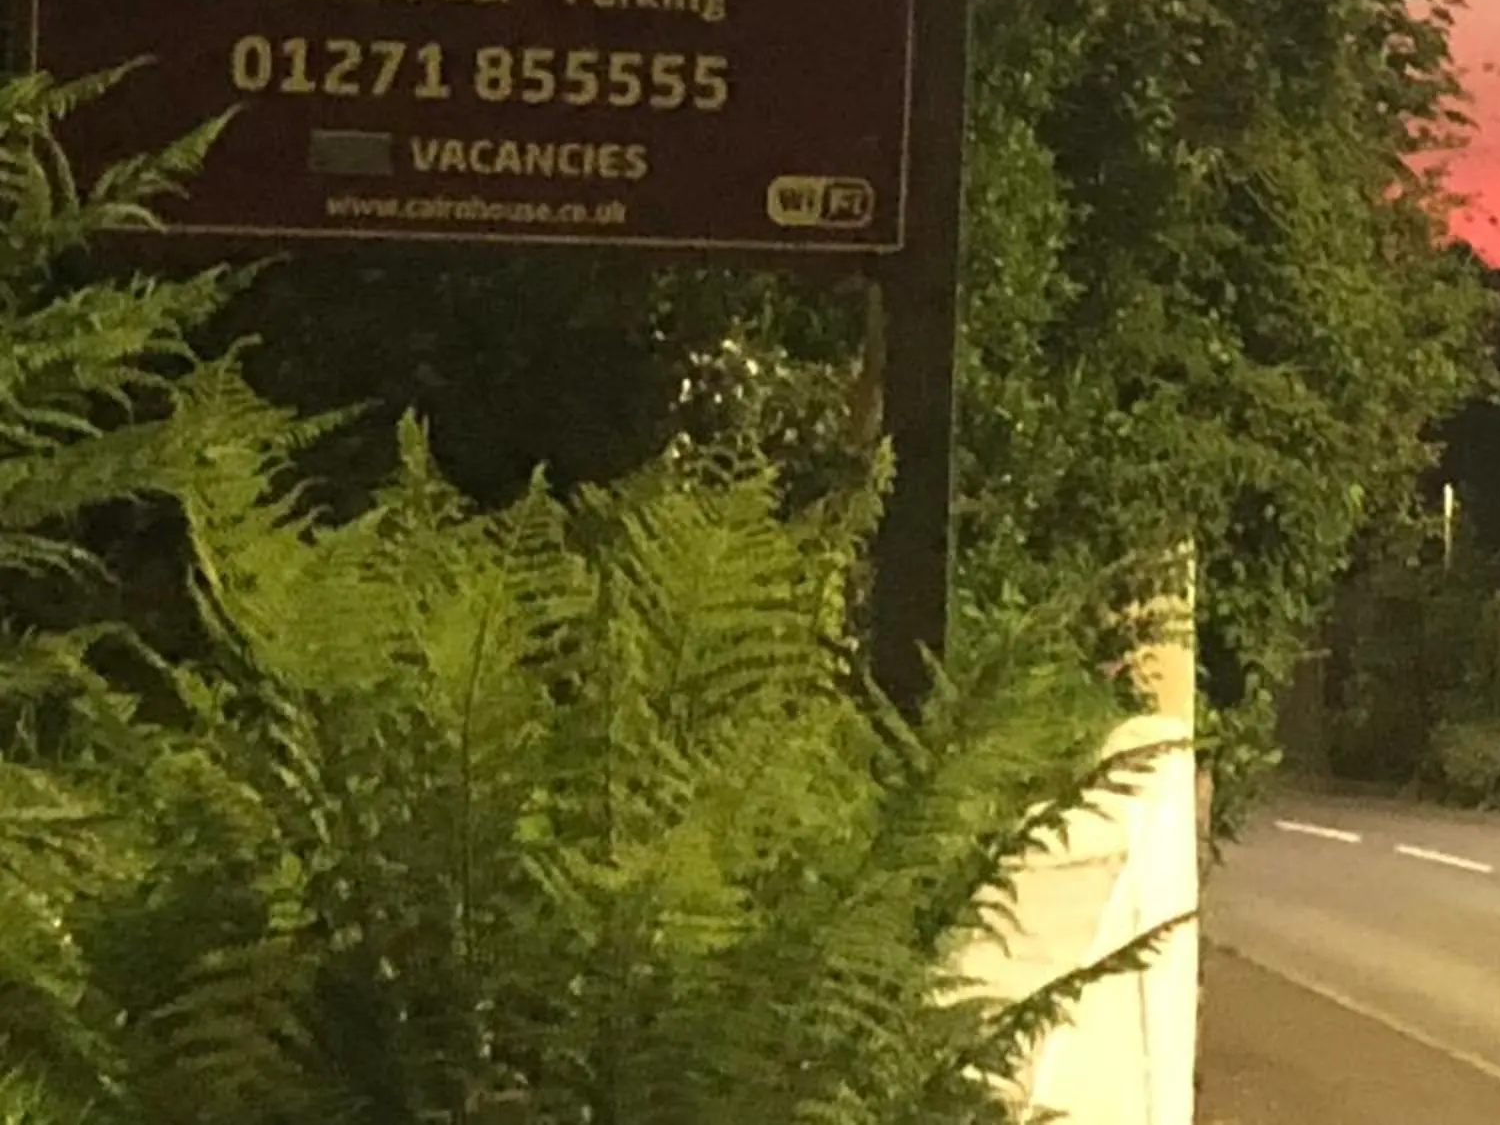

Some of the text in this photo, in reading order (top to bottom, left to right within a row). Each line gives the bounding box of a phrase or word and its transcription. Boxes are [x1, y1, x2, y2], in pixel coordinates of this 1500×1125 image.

[232, 35, 729, 111] 01271 855555
[410, 136, 649, 180] VACANCIES
[326, 194, 628, 225] www.cairnhouse.co.uk
